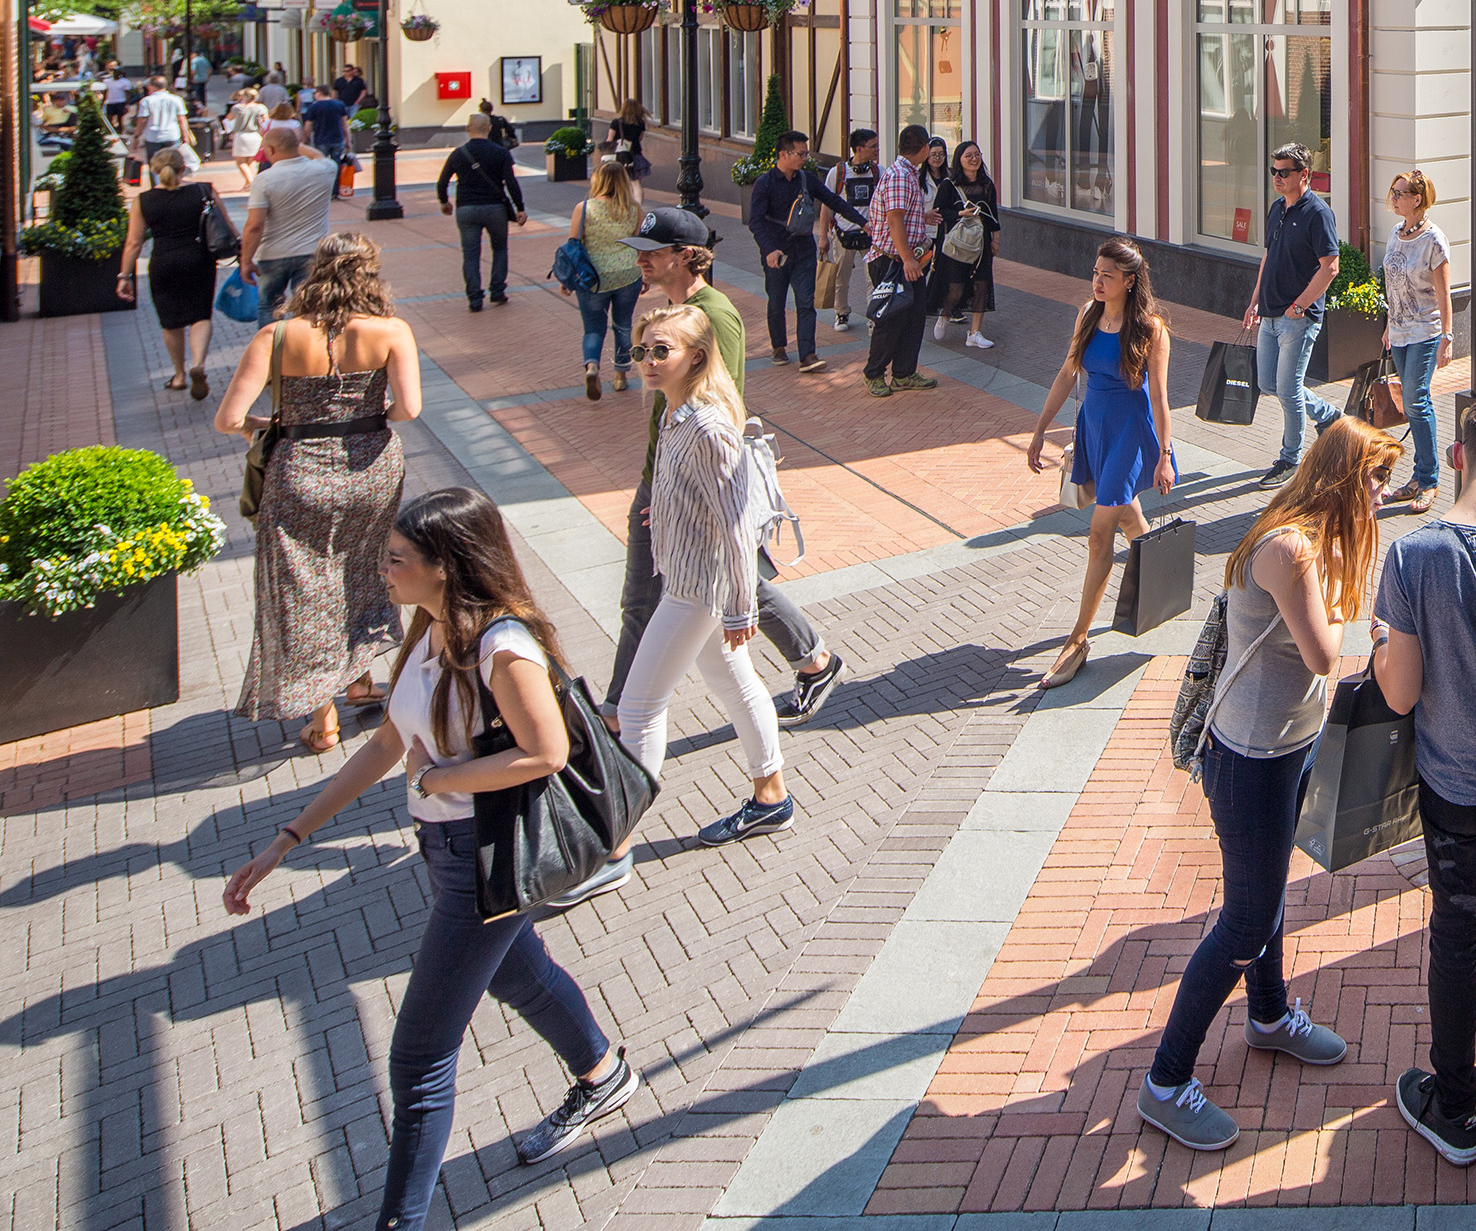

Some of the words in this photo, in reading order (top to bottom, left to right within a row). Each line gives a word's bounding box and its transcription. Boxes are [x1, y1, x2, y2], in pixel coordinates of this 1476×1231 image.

[1235, 220, 1247, 229] SALE
[1226, 379, 1250, 388] DIESEL
[1363, 819, 1392, 836] G-STAR
